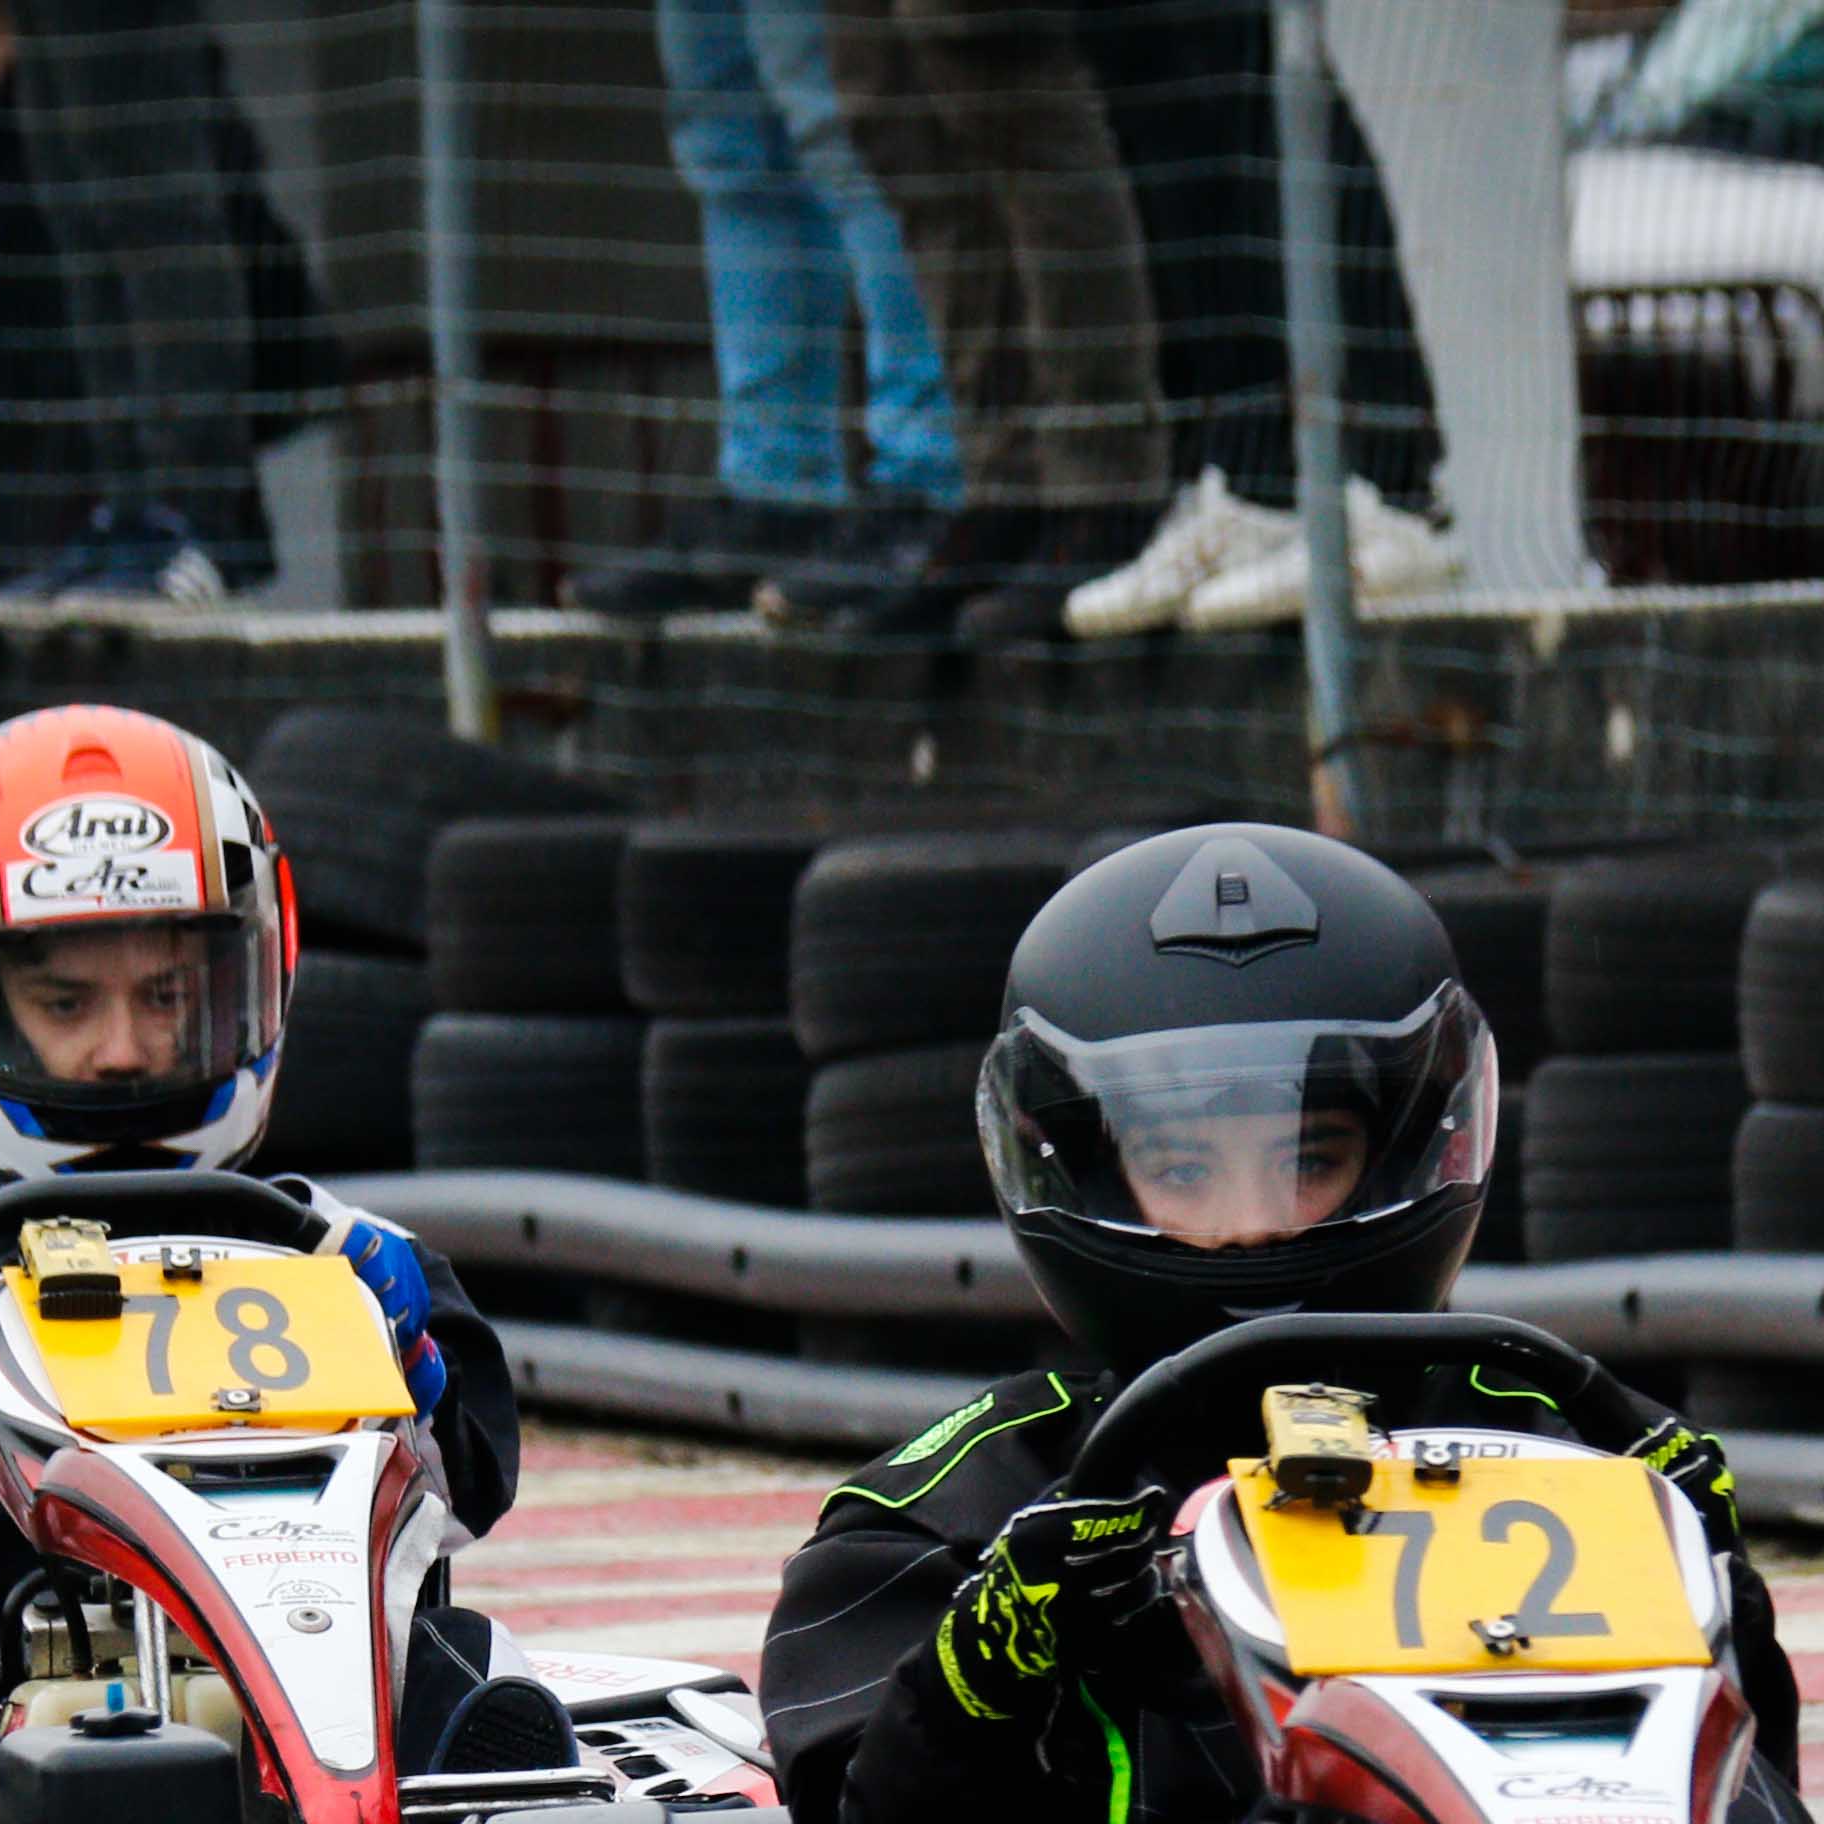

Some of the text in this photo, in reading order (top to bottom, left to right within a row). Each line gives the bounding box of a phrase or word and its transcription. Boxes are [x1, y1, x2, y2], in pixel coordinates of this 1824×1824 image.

[32, 803, 149, 842] Arai
[121, 1286, 310, 1396] 78
[1072, 1508, 1144, 1542] Speed
[223, 1551, 359, 1570] FERBERTO
[1366, 1499, 1611, 1649] 72
